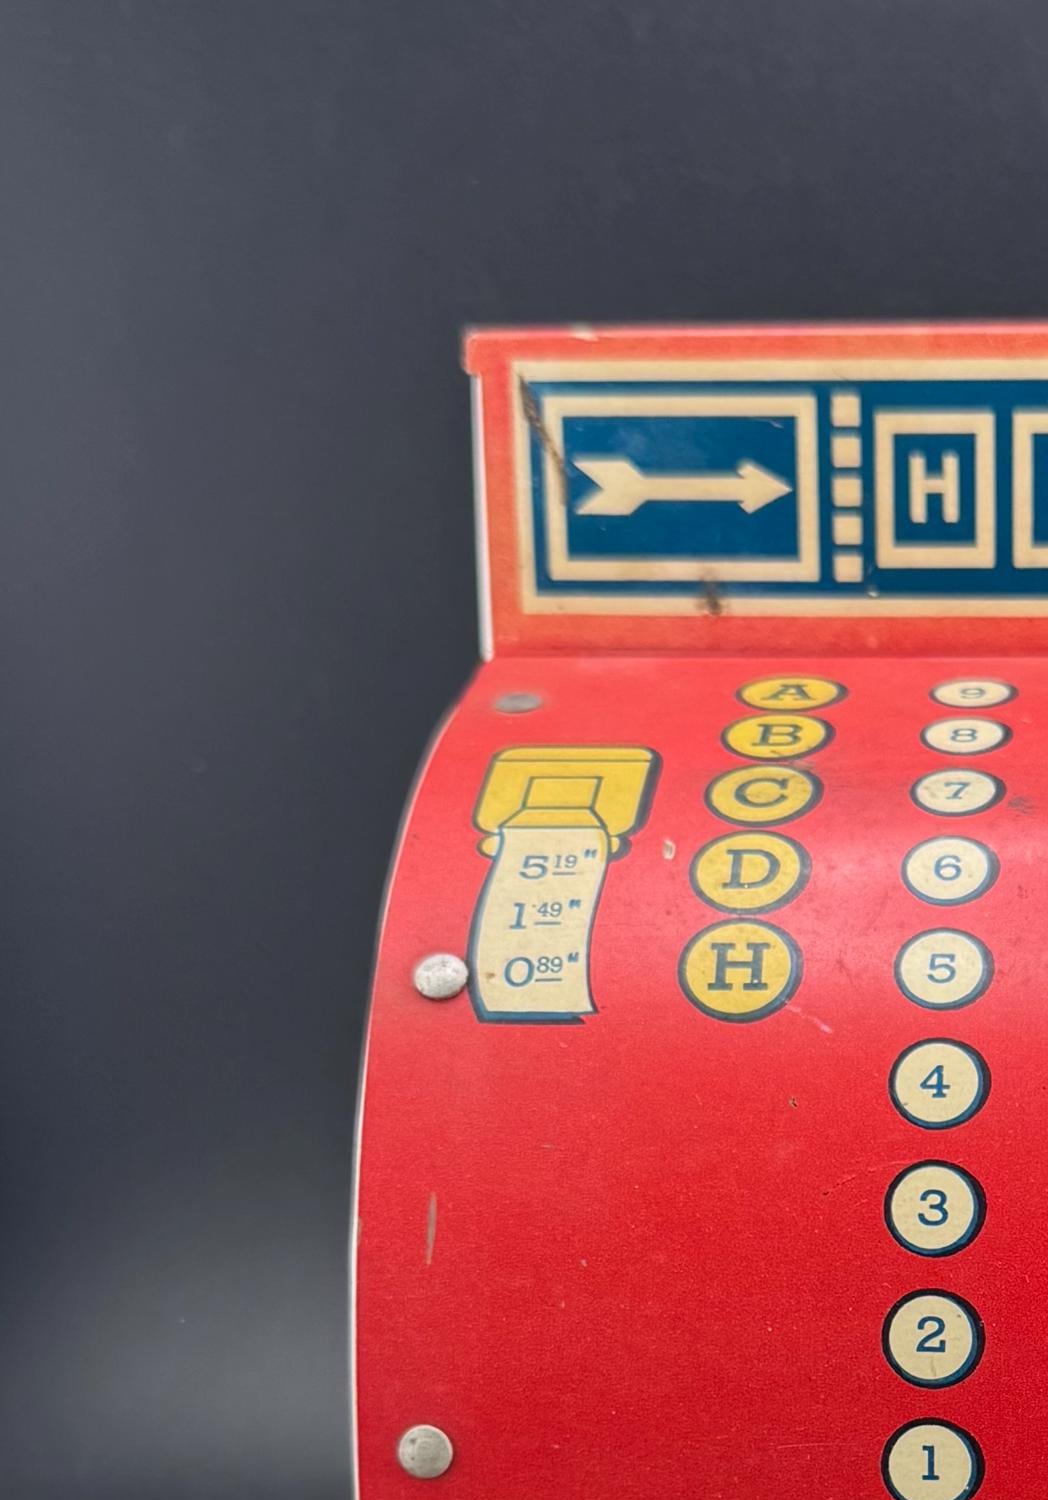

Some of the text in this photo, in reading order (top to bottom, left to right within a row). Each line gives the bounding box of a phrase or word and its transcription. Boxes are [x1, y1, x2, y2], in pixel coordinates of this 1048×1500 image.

[908, 451, 959, 524] H
[762, 683, 816, 701] A
[959, 687, 987, 700] 9
[751, 723, 803, 747] B
[950, 728, 979, 744] 8
[734, 778, 788, 808] C
[944, 782, 971, 800] 7
[721, 849, 781, 889] D
[933, 855, 963, 881] 6
[707, 942, 771, 991] H
[926, 953, 957, 983] 5
[920, 1065, 951, 1098] 4
[917, 1189, 949, 1226] 3
[916, 1317, 947, 1353] 2
[921, 1445, 940, 1481] 1
